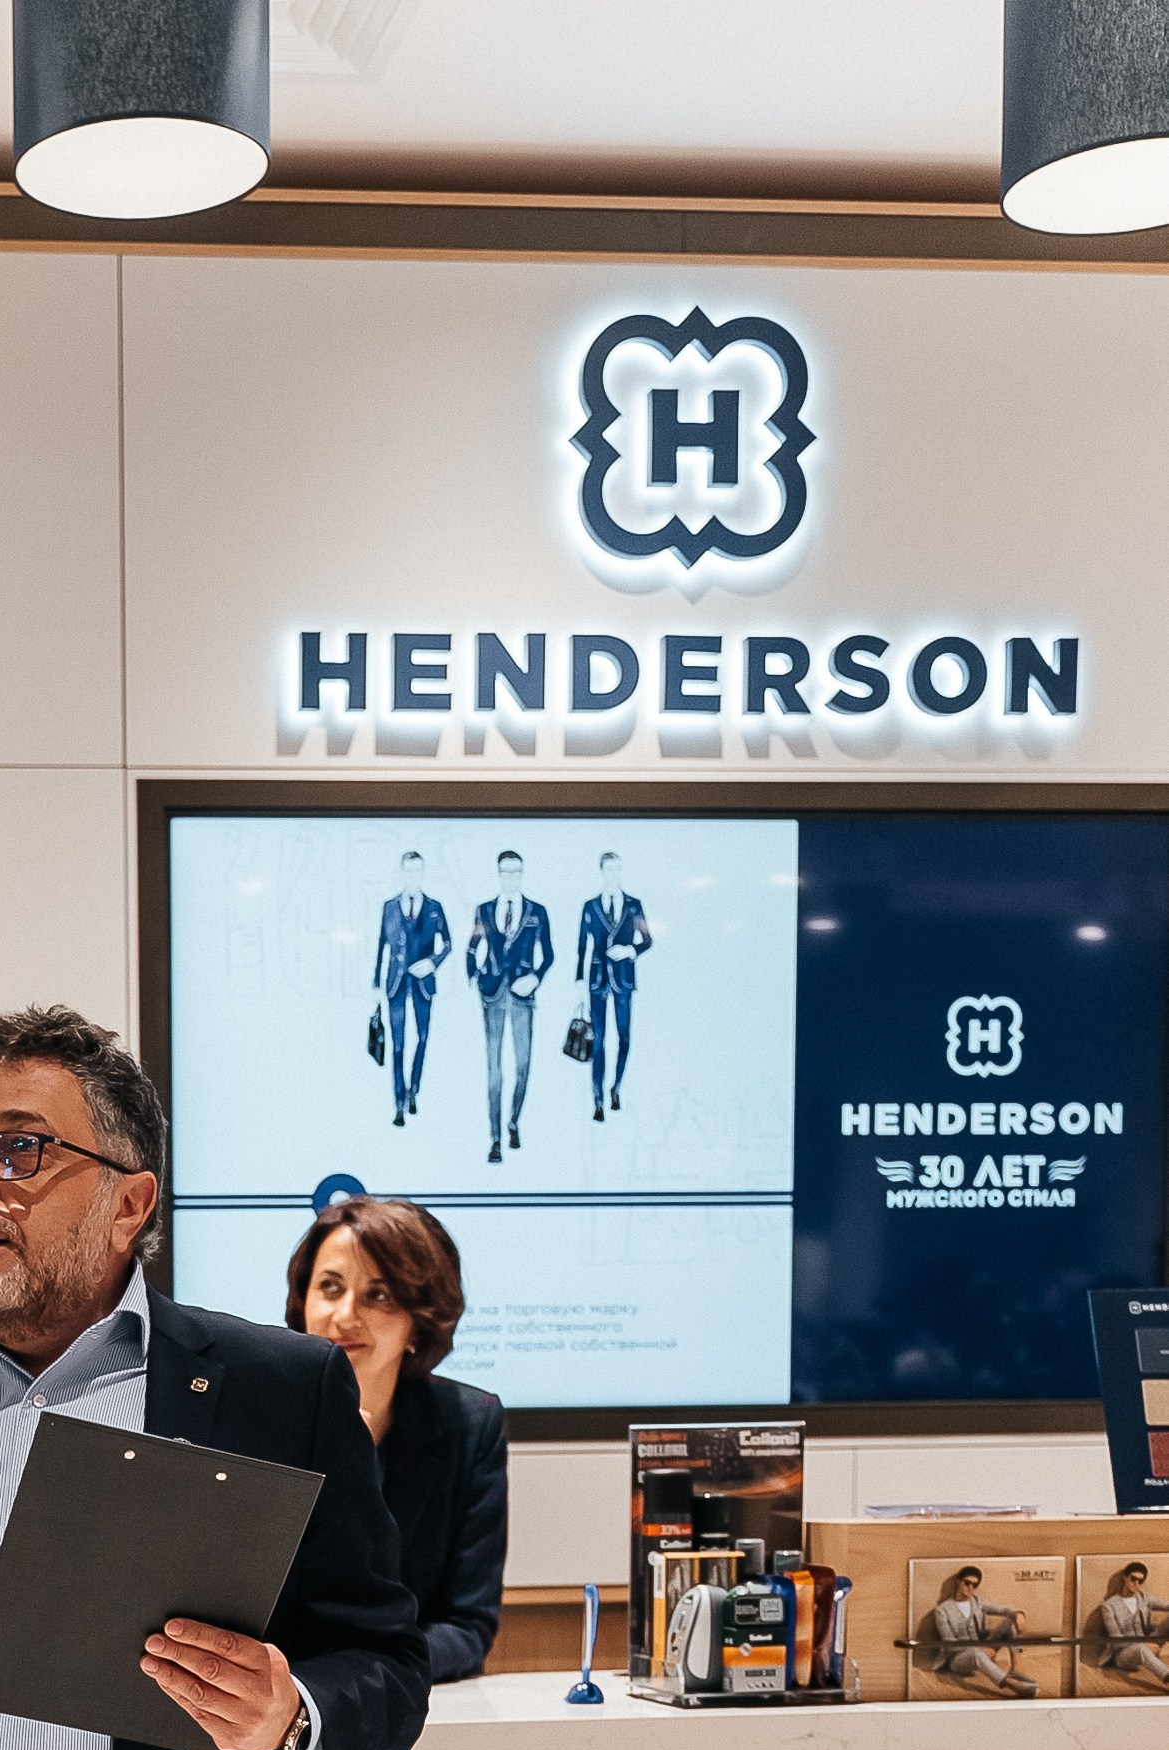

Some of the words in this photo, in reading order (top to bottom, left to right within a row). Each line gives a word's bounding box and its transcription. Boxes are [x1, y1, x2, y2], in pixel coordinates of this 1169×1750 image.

[298, 631, 1079, 716] HENDERSON
[840, 1101, 1124, 1136] HENDERSON
[918, 1154, 966, 1188] 30
[972, 1154, 1047, 1188] ЛЕТ
[885, 1188, 1005, 1209] МУЖСКОГО
[1006, 1187, 1077, 1208] СТИЛЯ
[505, 1303, 586, 1318] торговую
[590, 1303, 640, 1318] марку
[508, 1320, 624, 1335] собственного
[504, 1338, 566, 1353] первой
[570, 1336, 678, 1352] собственной
